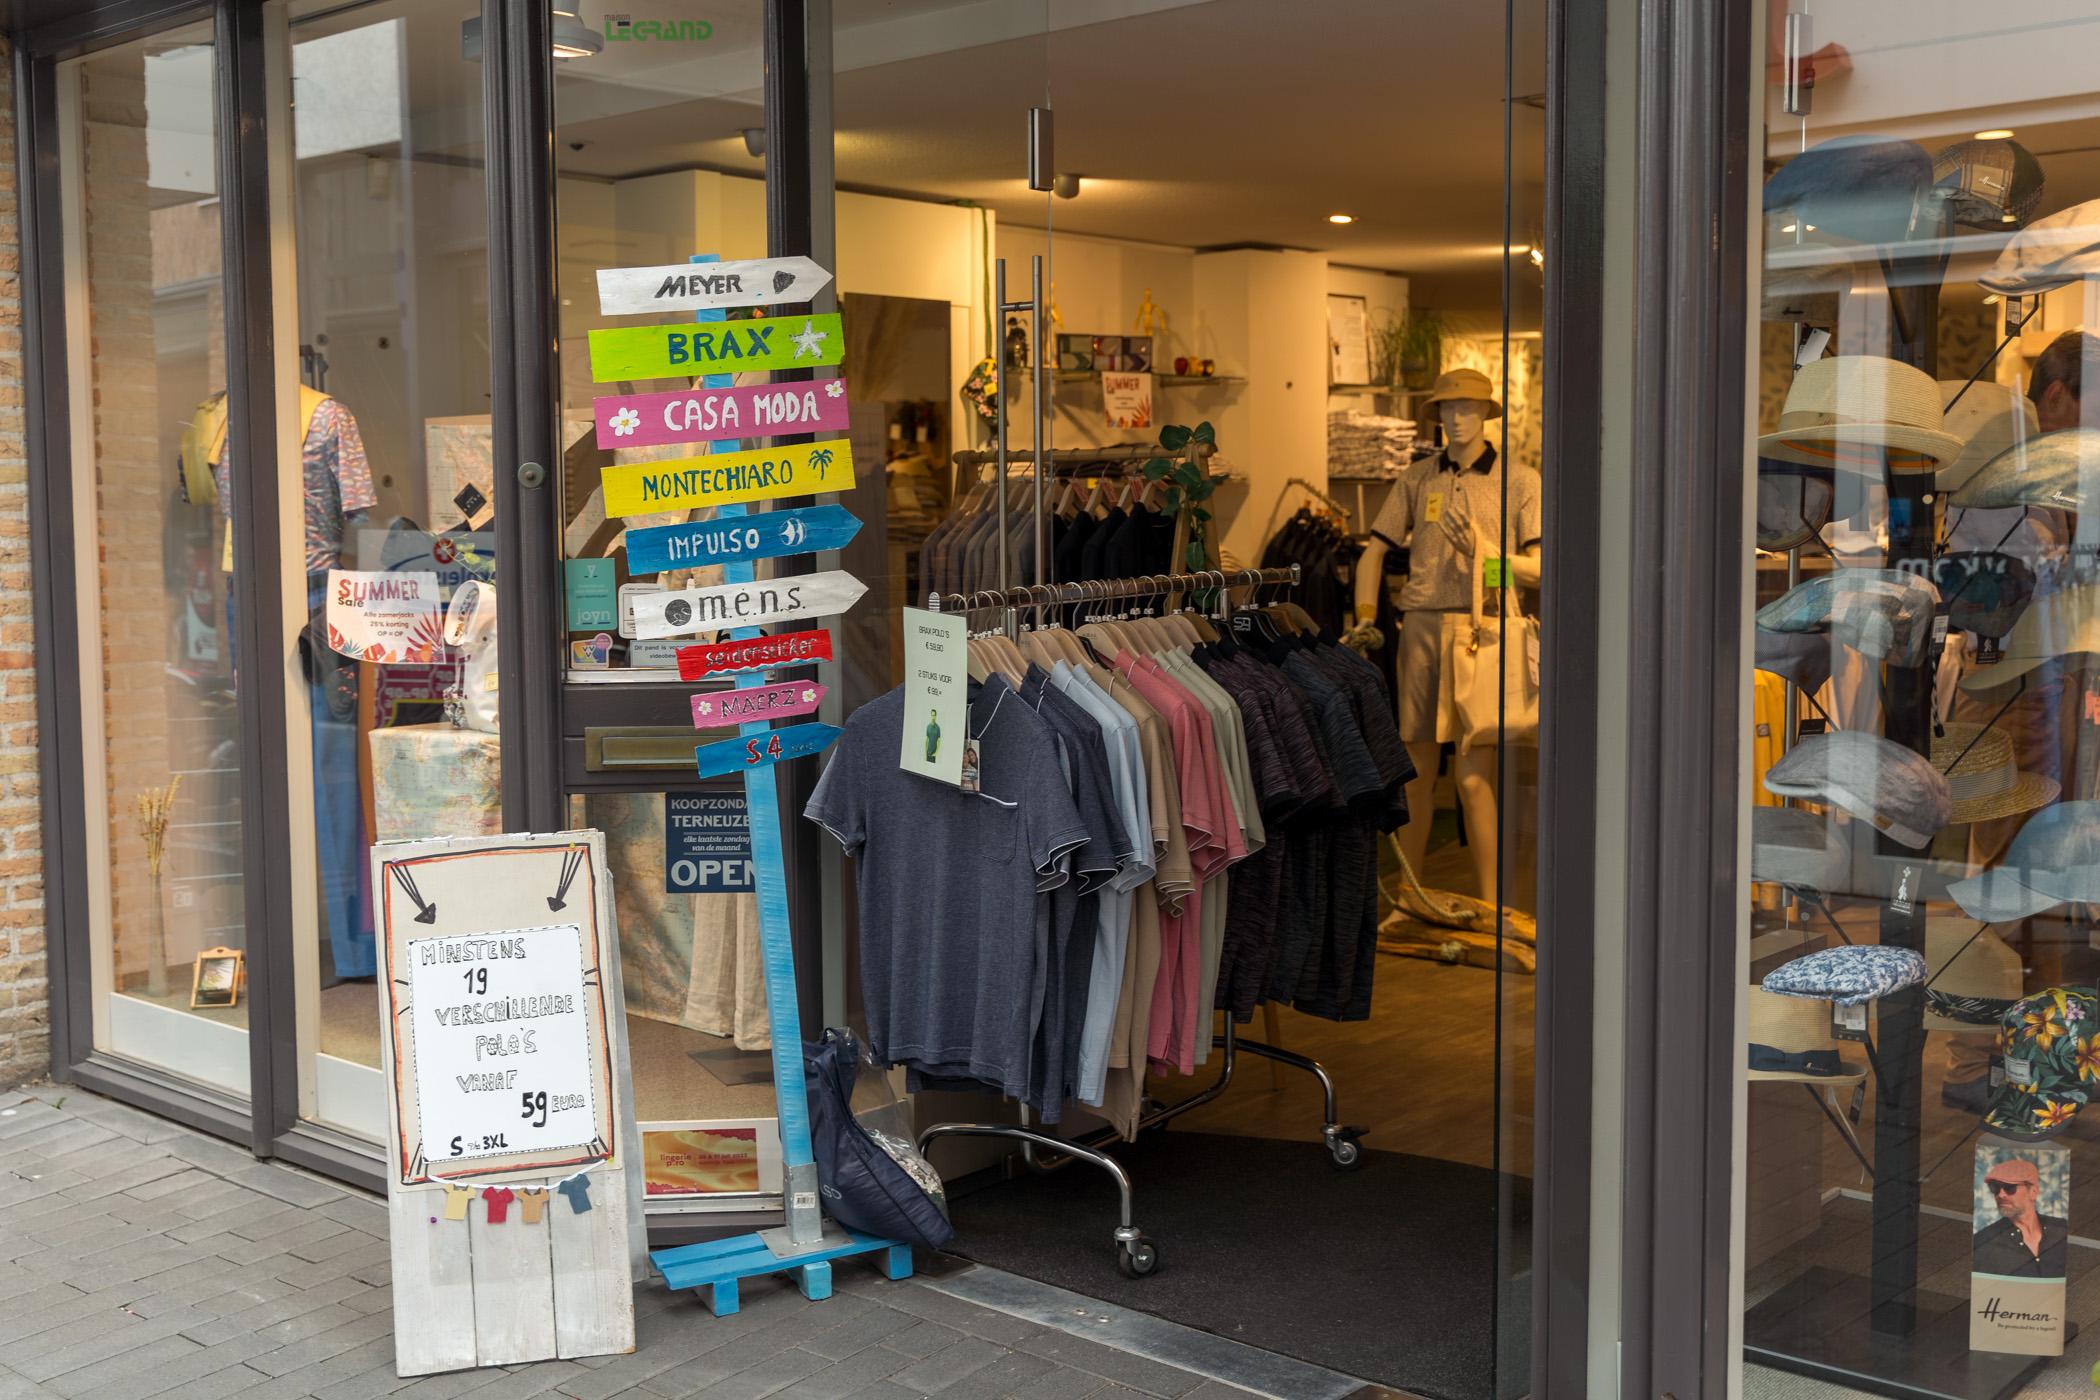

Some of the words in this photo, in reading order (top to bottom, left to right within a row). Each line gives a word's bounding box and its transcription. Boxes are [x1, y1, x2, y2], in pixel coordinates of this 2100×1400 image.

[654, 273, 744, 298] MEYER
[667, 326, 774, 365] BRAX
[663, 395, 740, 431] CASA
[753, 390, 820, 426] MODA
[642, 459, 793, 502] MONTECHIARO
[667, 528, 760, 561] IMPULSO
[338, 578, 420, 601] SUMMER
[337, 596, 364, 608] Sale
[378, 611, 415, 619] zomerjacks
[385, 621, 409, 629] korting
[576, 609, 611, 626] joyn
[704, 637, 818, 667] seidensticker
[922, 670, 938, 681] STUKS
[720, 688, 796, 719] MAERZ
[672, 815, 750, 828] TERNEUZE
[698, 835, 722, 843] laatste
[723, 835, 750, 845] zondag
[463, 967, 488, 995] 19
[456, 1070, 518, 1093] VANAF
[521, 1091, 547, 1128] 59
[552, 1094, 586, 1113] EURO
[450, 1135, 463, 1156] S
[483, 1133, 509, 1150] 3XL
[1977, 1297, 2058, 1323] Herman
